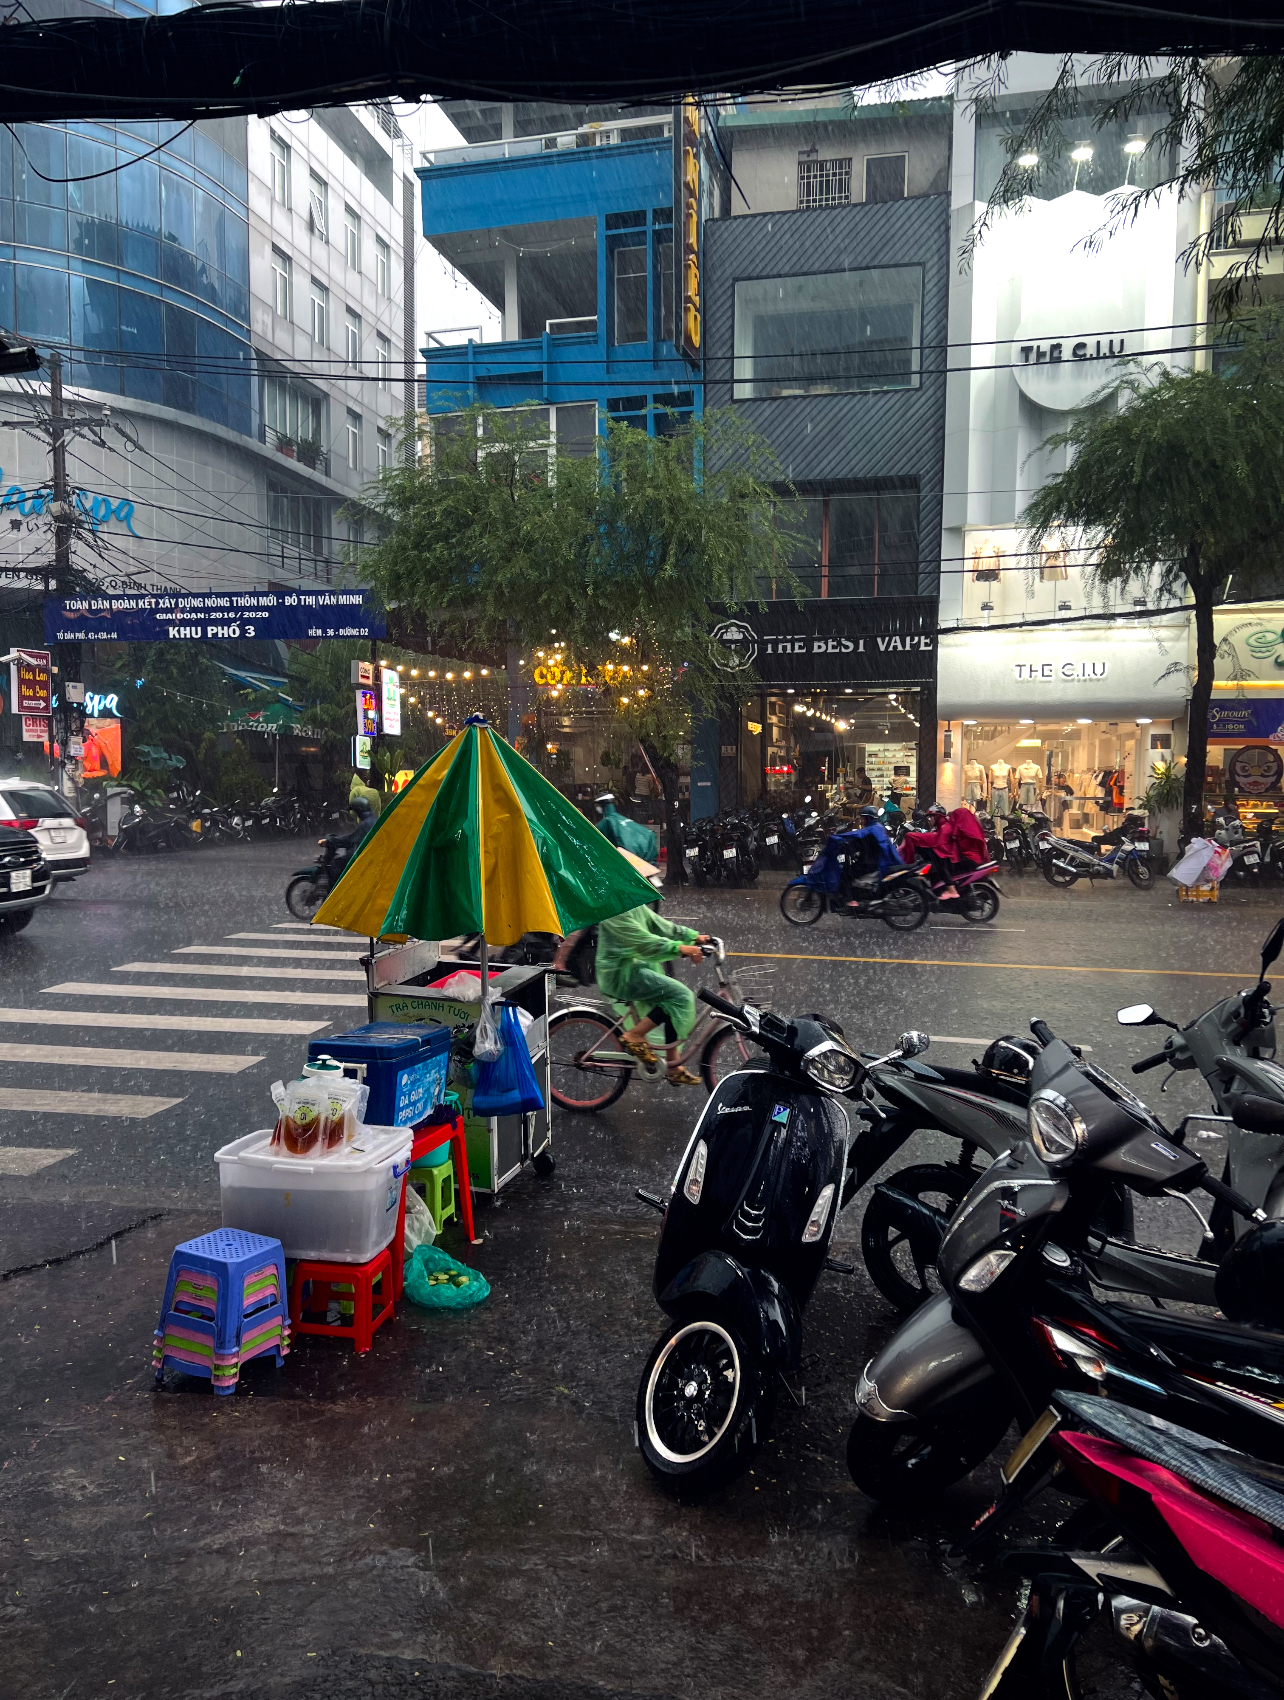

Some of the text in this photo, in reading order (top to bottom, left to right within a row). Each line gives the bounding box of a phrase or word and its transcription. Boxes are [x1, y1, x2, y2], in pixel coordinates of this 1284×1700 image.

[1020, 342, 1063, 362] THE
[65, 597, 89, 609] TOÀN
[91, 597, 110, 609] DÂN
[111, 597, 136, 609] ĐOÀN
[138, 595, 156, 608] KẾT
[158, 596, 176, 608] XÂY
[178, 596, 203, 611] DỰNG
[205, 595, 230, 607] NÔNG
[232, 595, 257, 606] THÔN
[259, 593, 277, 606] MỚI
[284, 593, 298, 606] ĐÔ
[300, 595, 316, 608] THỊ
[318, 593, 337, 605] VĂN
[338, 594, 363, 605] MINH
[168, 621, 256, 639] KHU PHỐ 3
[763, 635, 934, 654] THE BEST VAPE
[20, 666, 48, 681] Hoa Lan
[1014, 663, 1053, 679] THE
[21, 684, 48, 698] Hoa Ban
[84, 691, 124, 717] spa
[24, 716, 48, 728] CRIS
[388, 999, 470, 1022] TRÀ CHANH TƯƠI
[717, 1102, 753, 1115] Vespa
